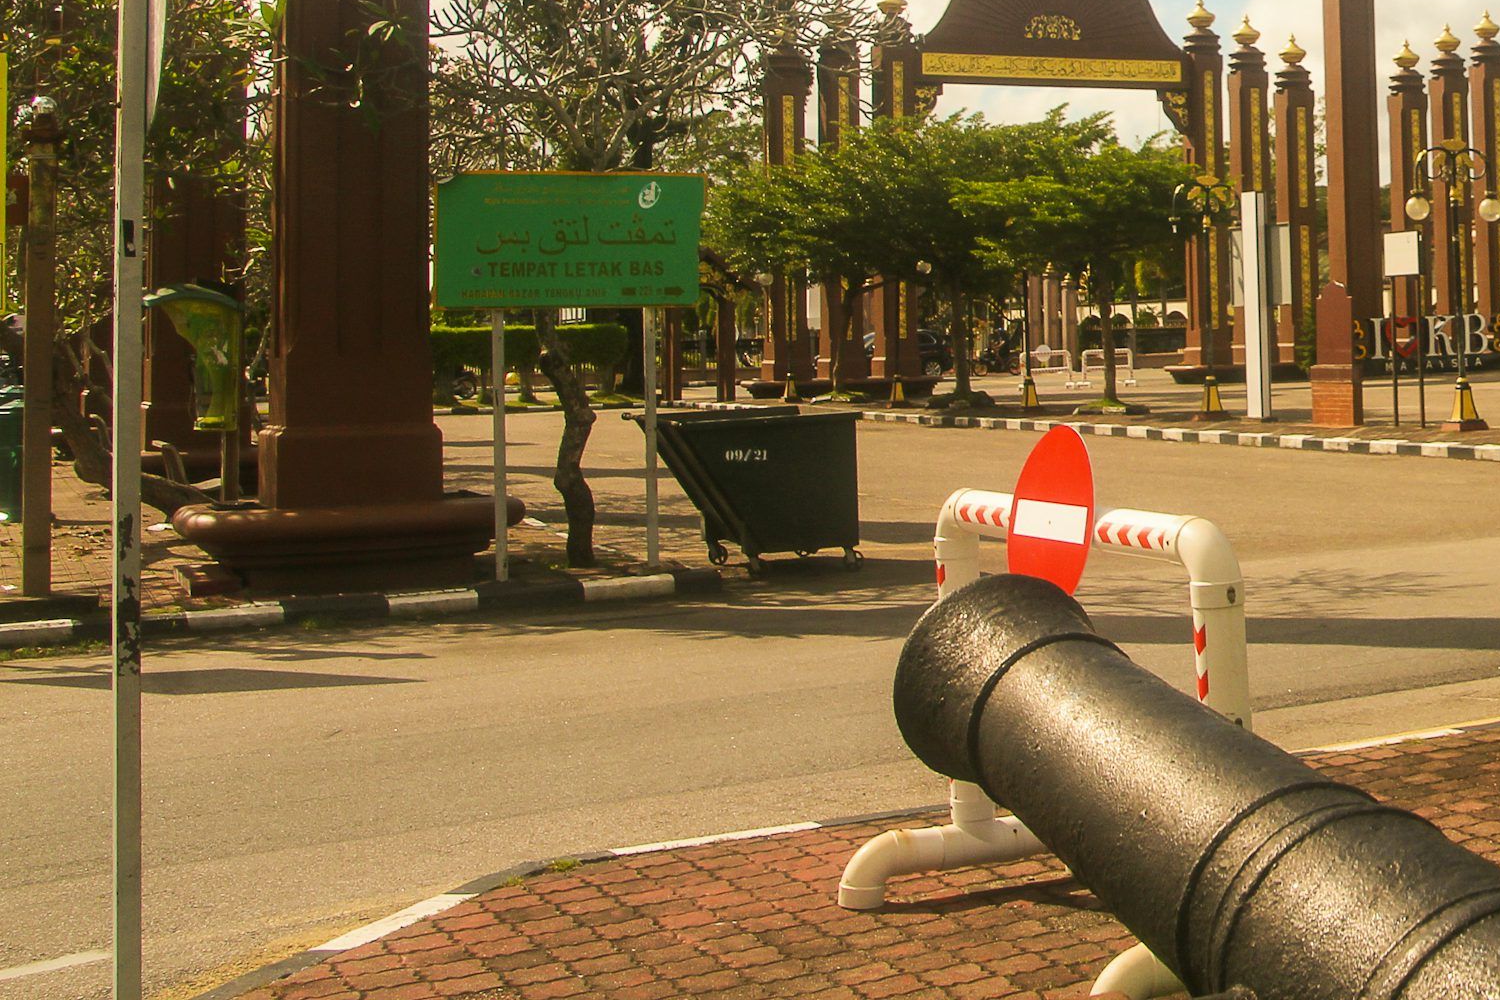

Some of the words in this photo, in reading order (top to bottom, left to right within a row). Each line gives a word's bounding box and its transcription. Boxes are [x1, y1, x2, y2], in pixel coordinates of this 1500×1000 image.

[487, 262, 558, 277] TEMPAT
[564, 261, 623, 276] LETAK
[629, 260, 665, 276] BAS
[1370, 318, 1385, 359] I
[1424, 313, 1490, 357] KB
[725, 449, 768, 462] 09/21
